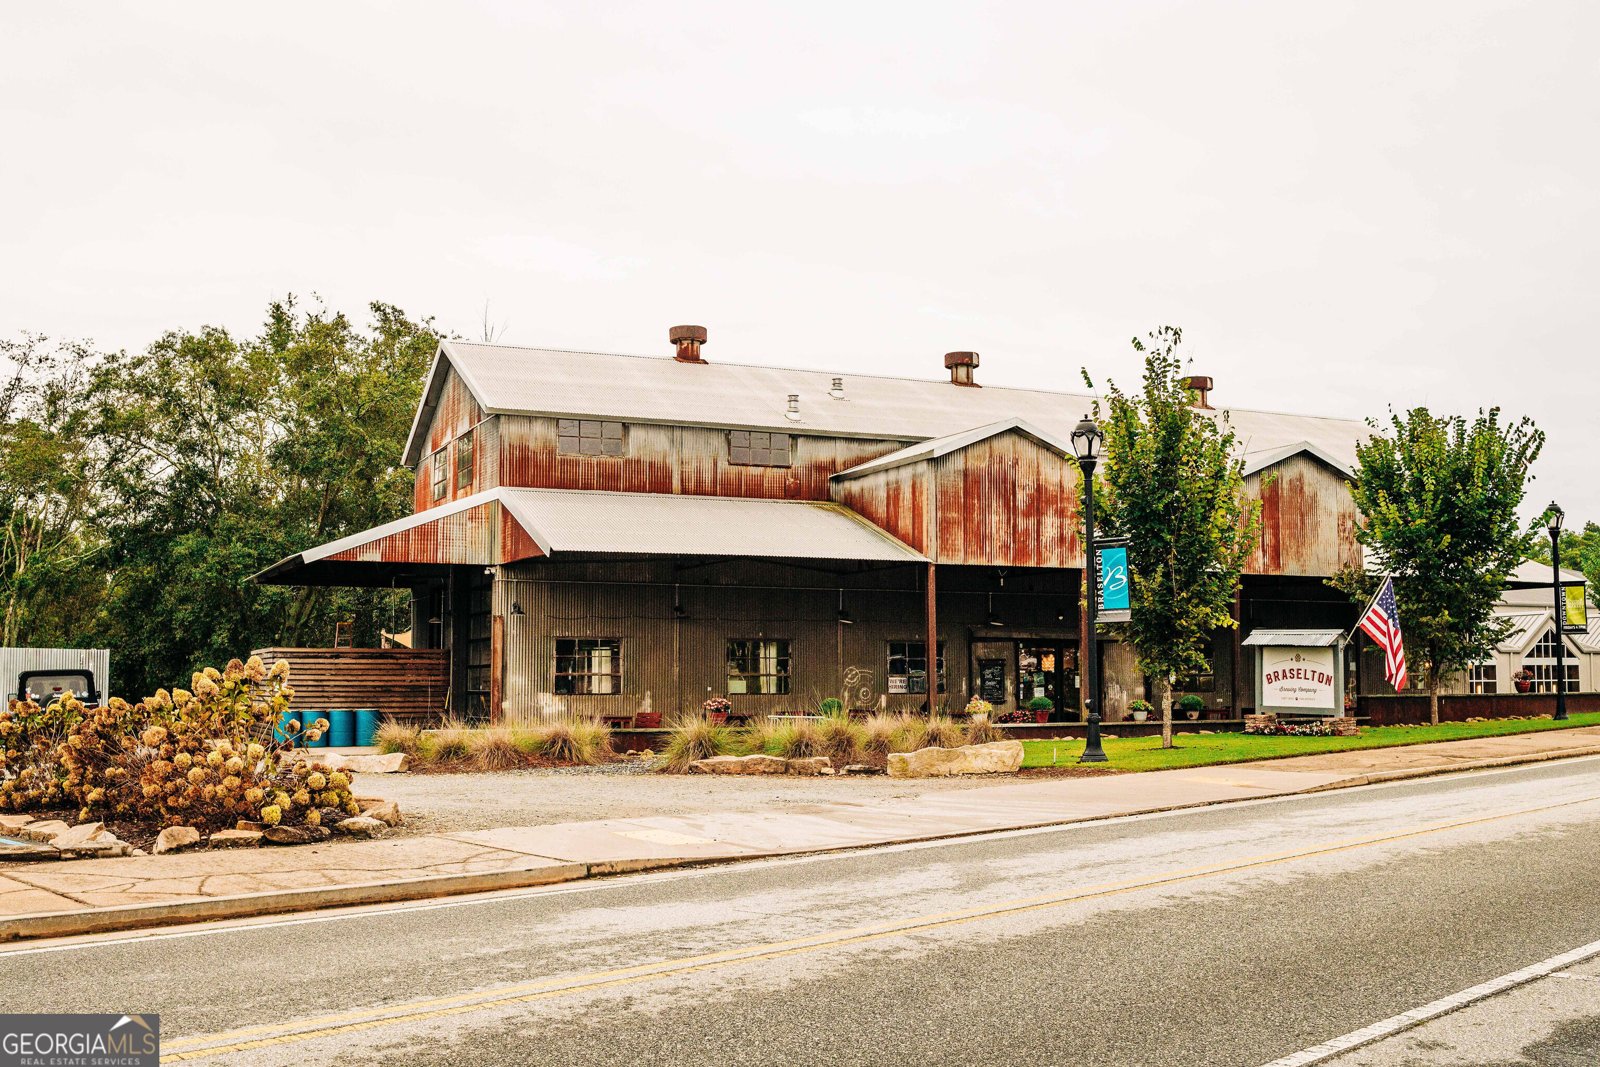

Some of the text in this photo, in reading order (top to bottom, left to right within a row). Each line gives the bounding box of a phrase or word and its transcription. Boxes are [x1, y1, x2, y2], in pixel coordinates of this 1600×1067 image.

[1096, 549, 1104, 610] BRASELTON
[1104, 566, 1127, 590] B
[1265, 668, 1333, 687] BRASELTON
[1298, 686, 1318, 694] Company
